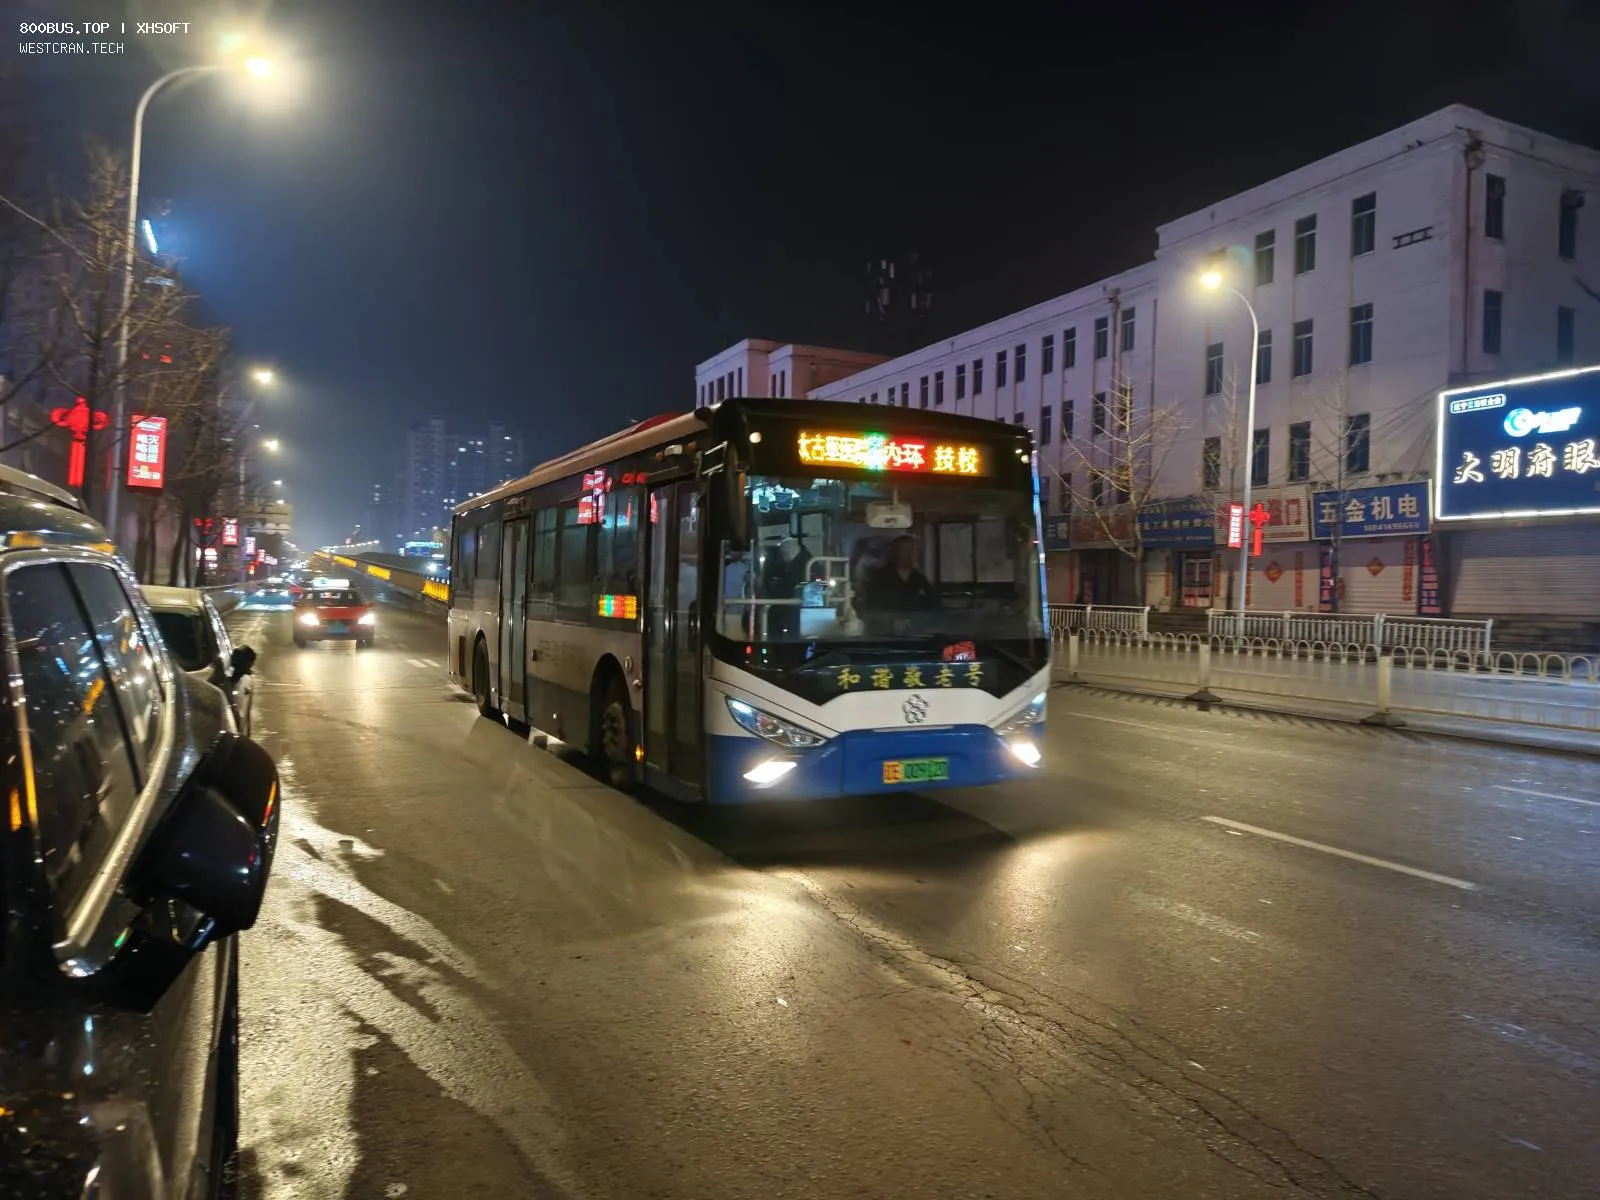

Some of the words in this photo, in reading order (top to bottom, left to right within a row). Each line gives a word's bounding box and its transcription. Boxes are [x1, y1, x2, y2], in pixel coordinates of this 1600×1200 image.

[885, 441, 925, 470] 内环
[1319, 492, 1421, 524] 五金机电
[837, 663, 985, 690] 和谐敬老号
